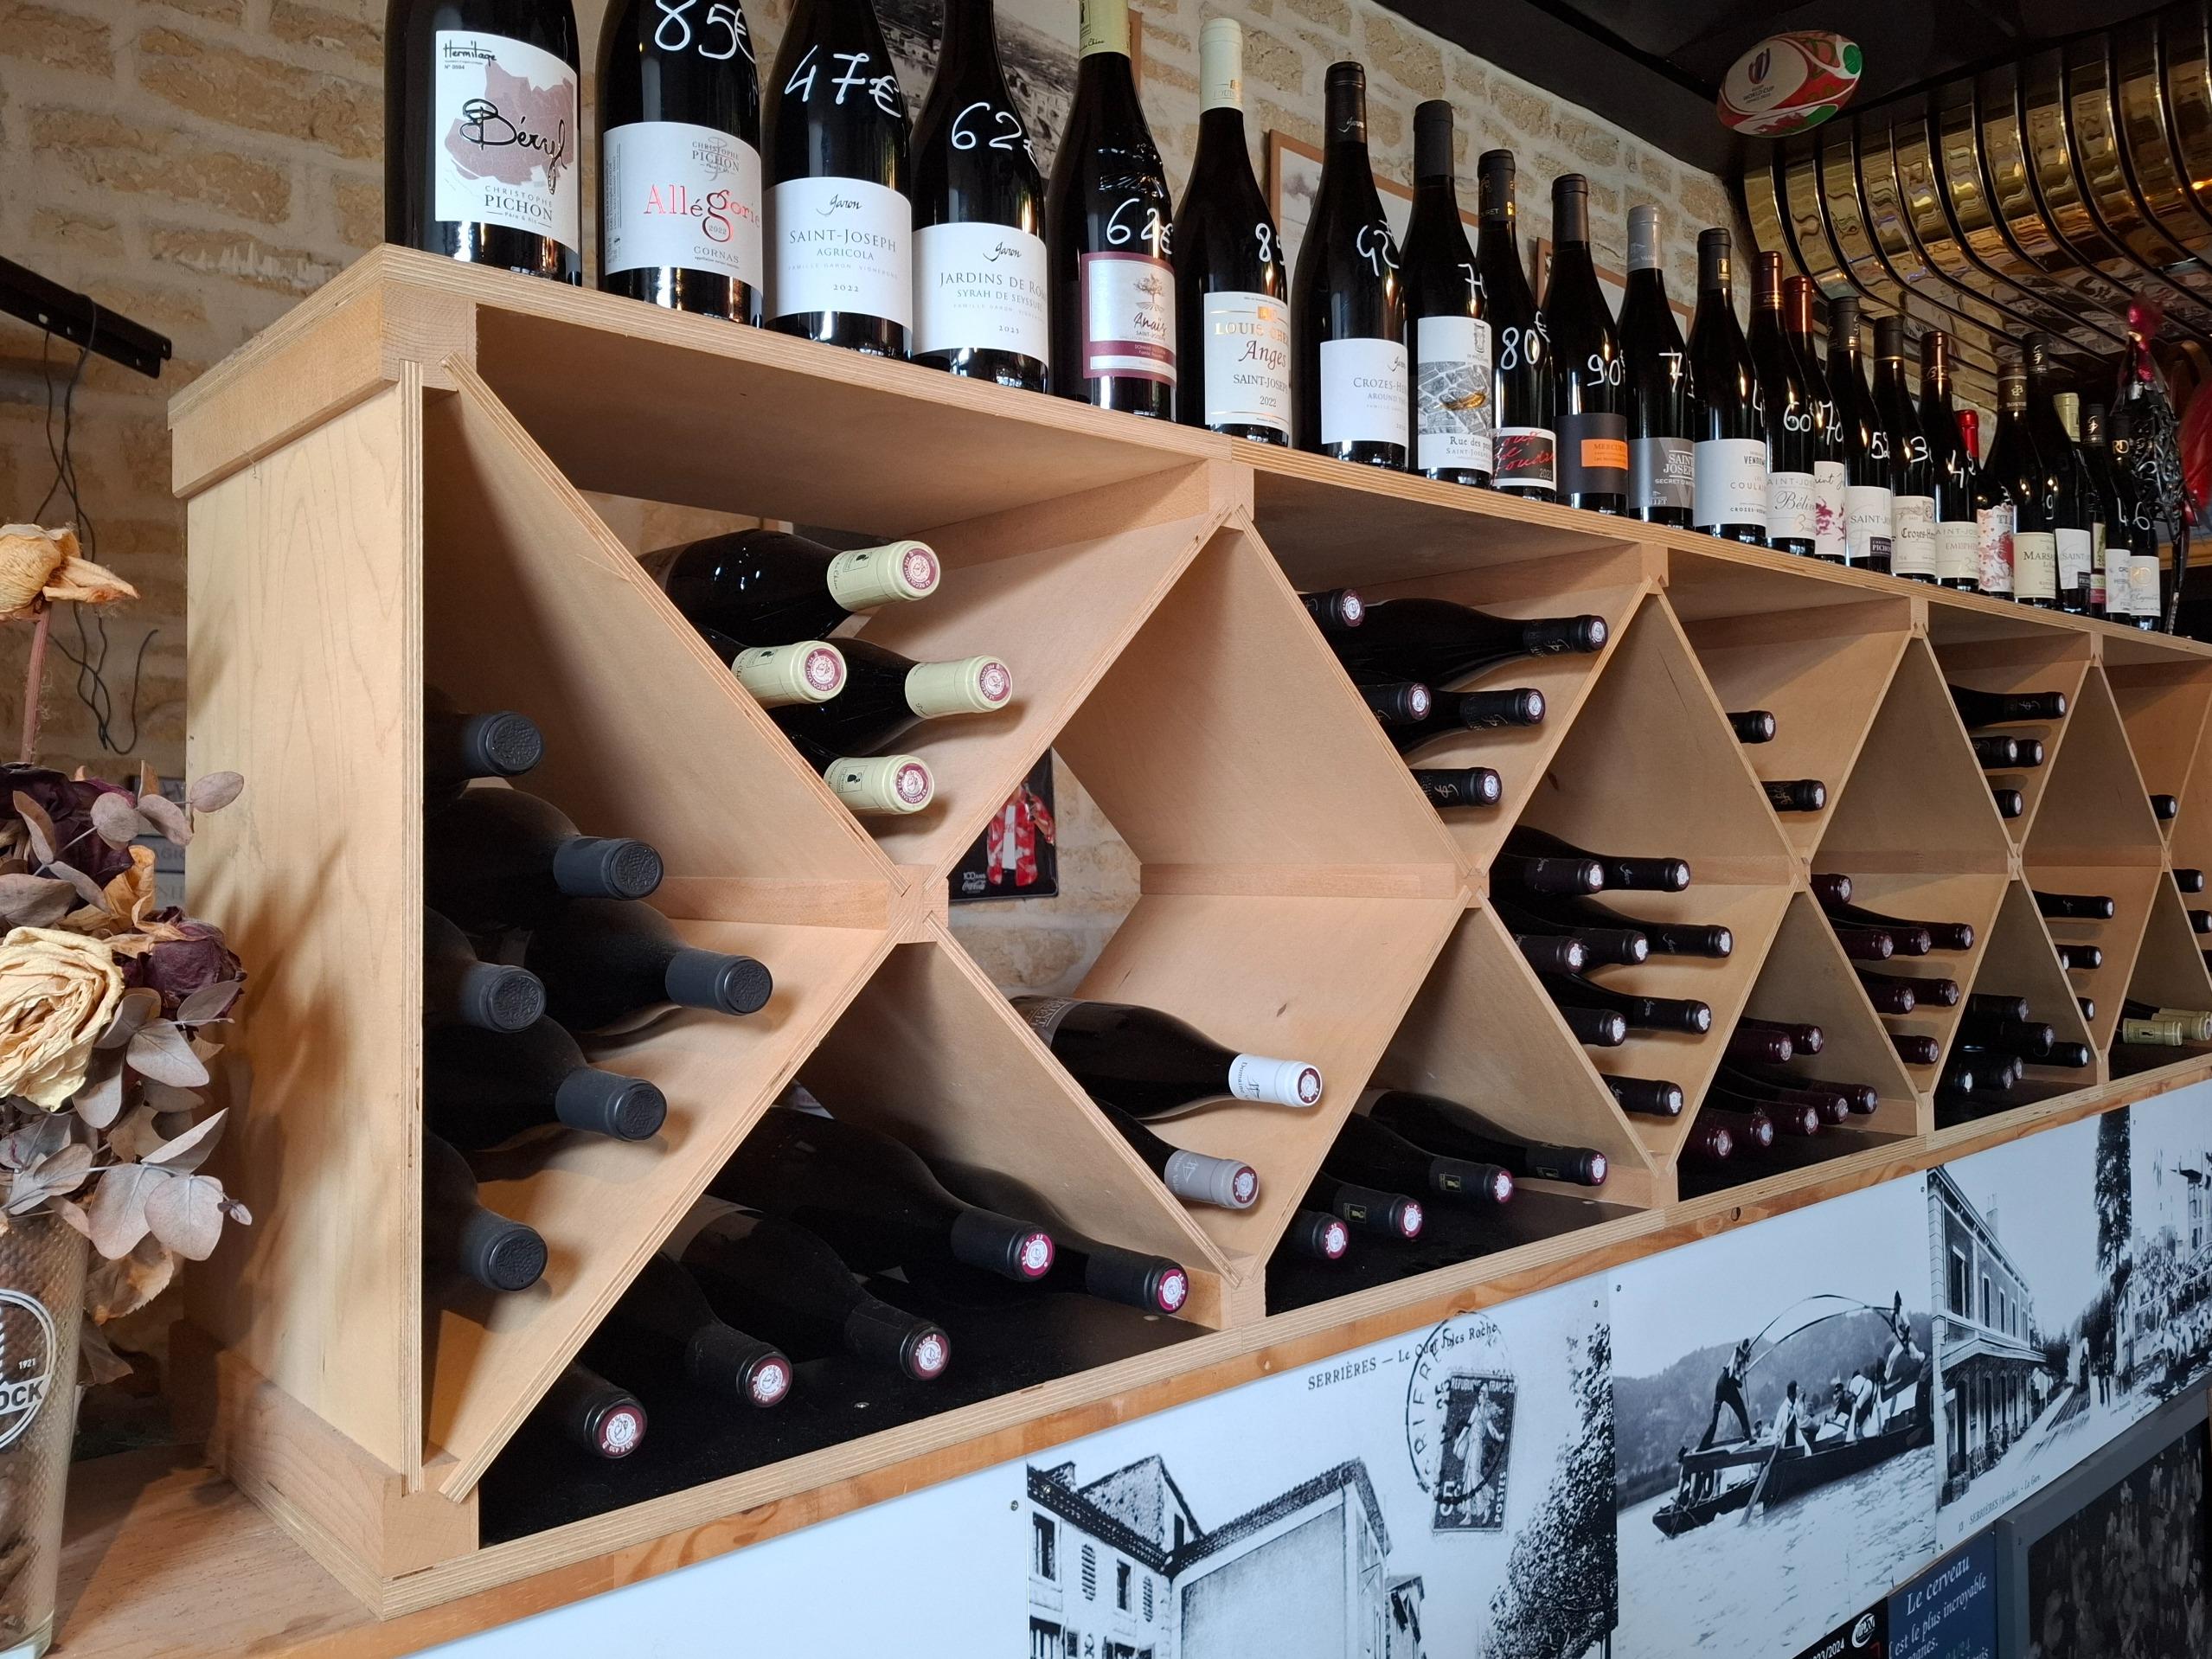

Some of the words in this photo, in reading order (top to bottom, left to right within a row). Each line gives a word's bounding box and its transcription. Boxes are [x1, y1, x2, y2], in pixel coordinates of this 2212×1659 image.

[443, 40, 497, 67] Hermitage
[459, 99, 567, 195] Béryl
[692, 141, 739, 159] CHRISTOPHE
[692, 151, 740, 172] PICHON
[484, 185, 553, 208] CHRISTOPHE
[484, 194, 553, 221] PICHON
[644, 183, 760, 243] Allégorie
[708, 224, 728, 234] 2022
[789, 229, 896, 252] SAINT-JOSEPH
[694, 245, 740, 264] CORNAS
[817, 247, 874, 260] AGRICOLA
[833, 284, 859, 292] 2022
[939, 272, 1003, 288] JARDINS
[1010, 276, 1024, 290] DE
[957, 289, 991, 298] SYRAH
[996, 291, 1008, 301] DE
[1215, 322, 1265, 336] LOUIS
[1238, 340, 1287, 370] Anges
[1260, 395, 1278, 408] 2022
[1450, 436, 1468, 445] Rue
[1471, 438, 1481, 448] des
[18, 1358, 37, 1370] 1921
[1307, 1356, 1377, 1391] SERRIÈRES
[1398, 1348, 1410, 1363] Le
[1494, 1470, 1507, 1522] POSTES
[1907, 1592, 1923, 1617] Le
[1926, 1556, 1971, 1601] cerveau
[1895, 1634, 1908, 1656] est
[1911, 1623, 1920, 1643] le
[1921, 1610, 1941, 1643] plus
[1943, 1572, 1987, 1618] incroyable
